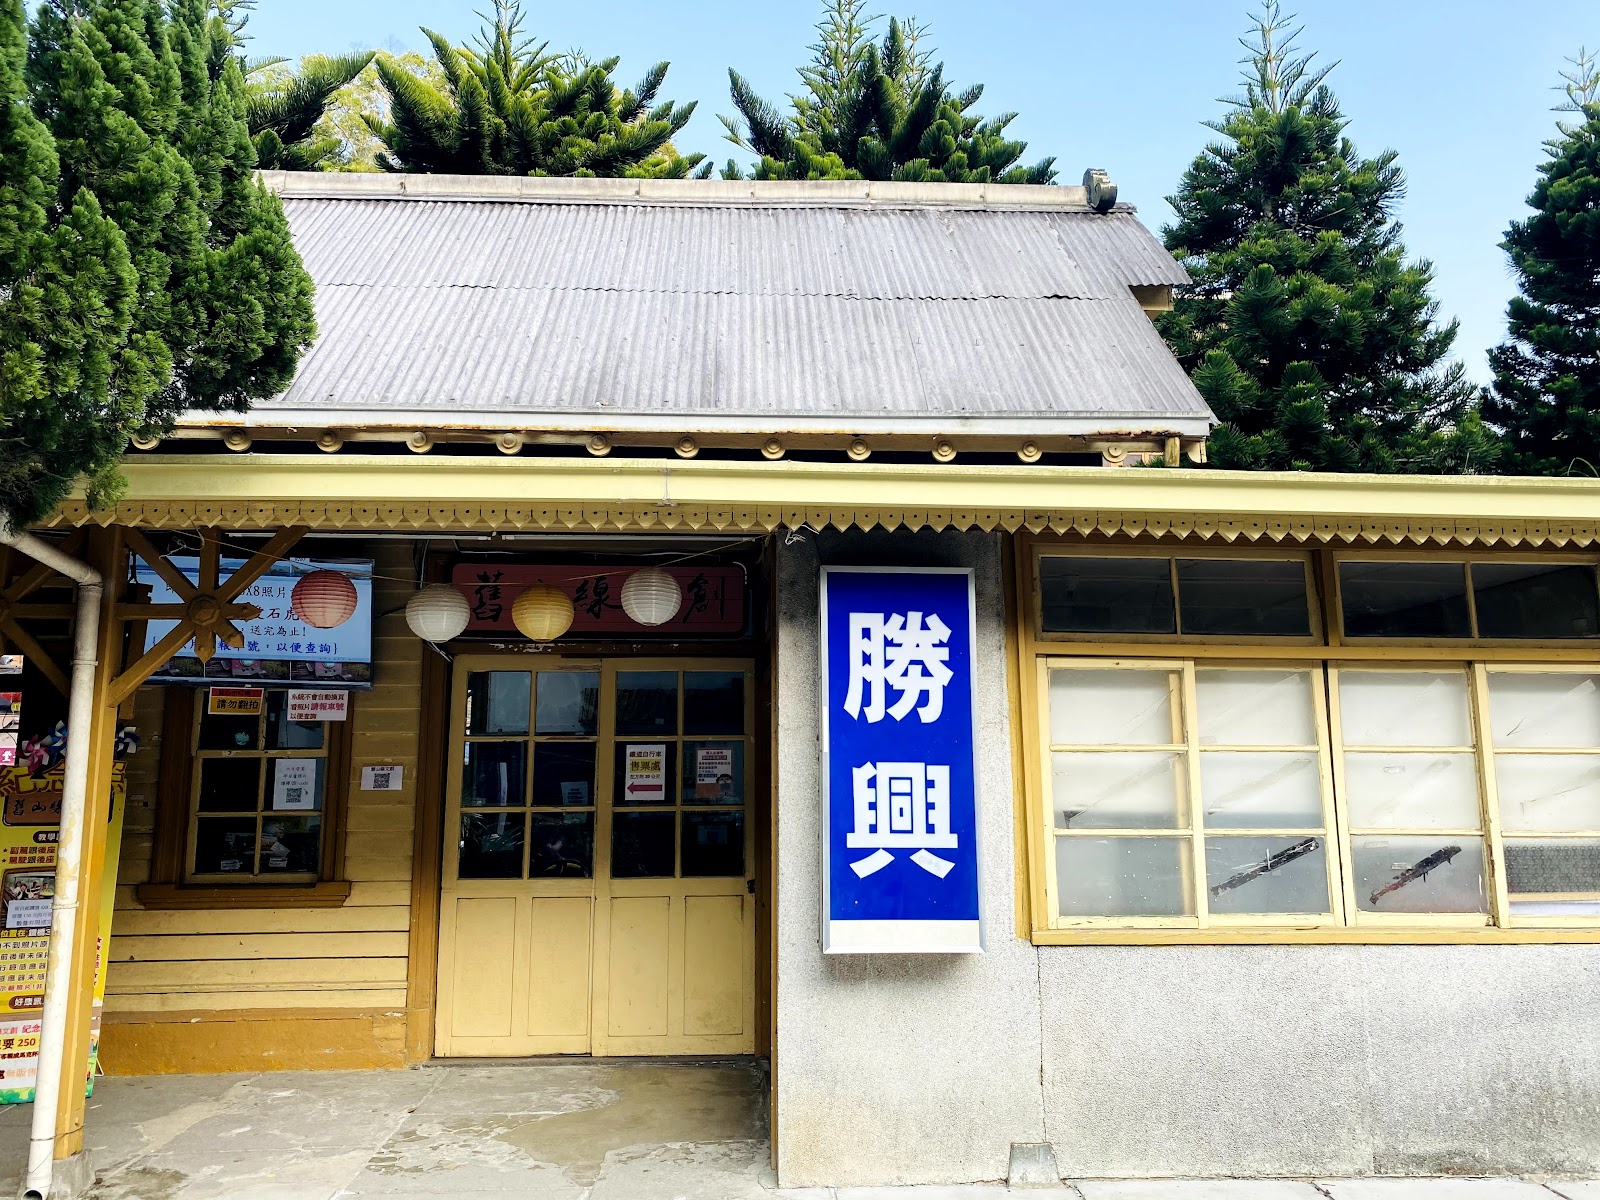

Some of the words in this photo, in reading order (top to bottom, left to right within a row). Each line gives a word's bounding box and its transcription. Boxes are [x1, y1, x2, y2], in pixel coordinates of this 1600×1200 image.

[472, 570, 726, 624] 舊線創
[216, 699, 259, 709] 請勿翻拍
[843, 611, 959, 879] 勝興
[630, 760, 661, 771] 售票處
[37, 832, 59, 841] 教學
[0, 940, 48, 949] 不到照片原
[17, 1037, 36, 1047] 250
